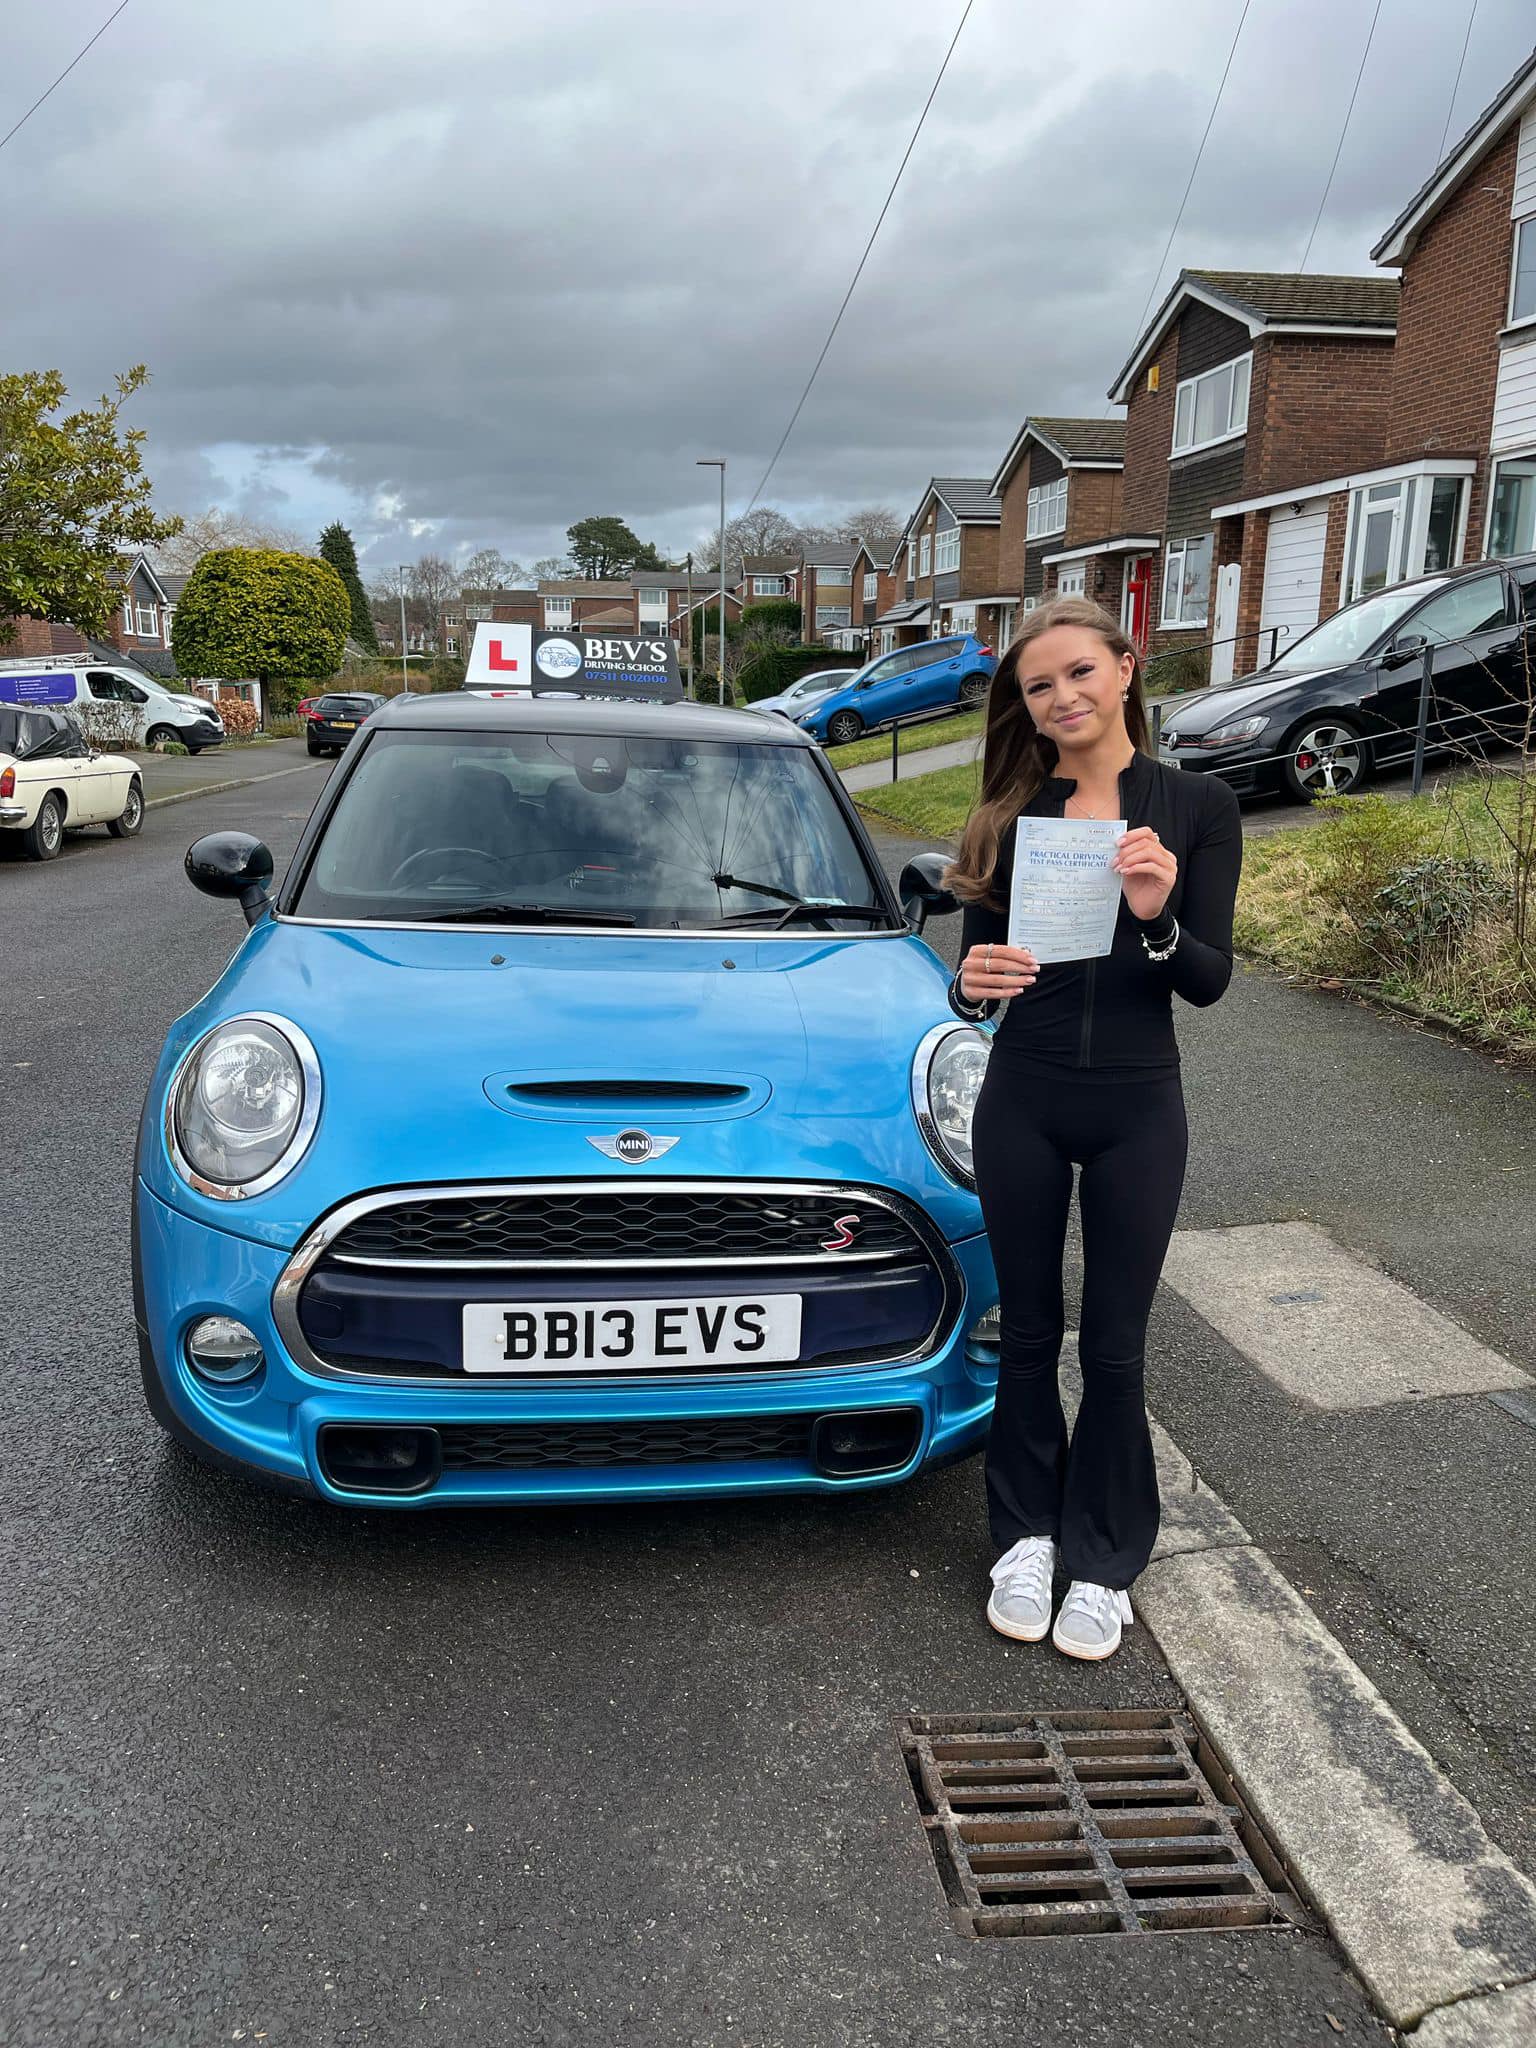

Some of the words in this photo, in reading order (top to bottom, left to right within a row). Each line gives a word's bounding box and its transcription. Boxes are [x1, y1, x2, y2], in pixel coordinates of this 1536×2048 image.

[489, 640, 517, 671] L
[584, 638, 668, 662] BEV'S
[584, 660, 626, 671] DRIVING
[627, 663, 668, 673] SCHOOL
[585, 671, 617, 681] 07511
[621, 673, 668, 684] 002000
[1030, 850, 1070, 860] PRACTICAL
[1073, 852, 1108, 860] DRIVING
[1064, 860, 1108, 868] CERTIFICATE
[620, 1140, 649, 1150] MINI
[503, 1309, 635, 1361] BB13
[654, 1304, 767, 1356] EVS
